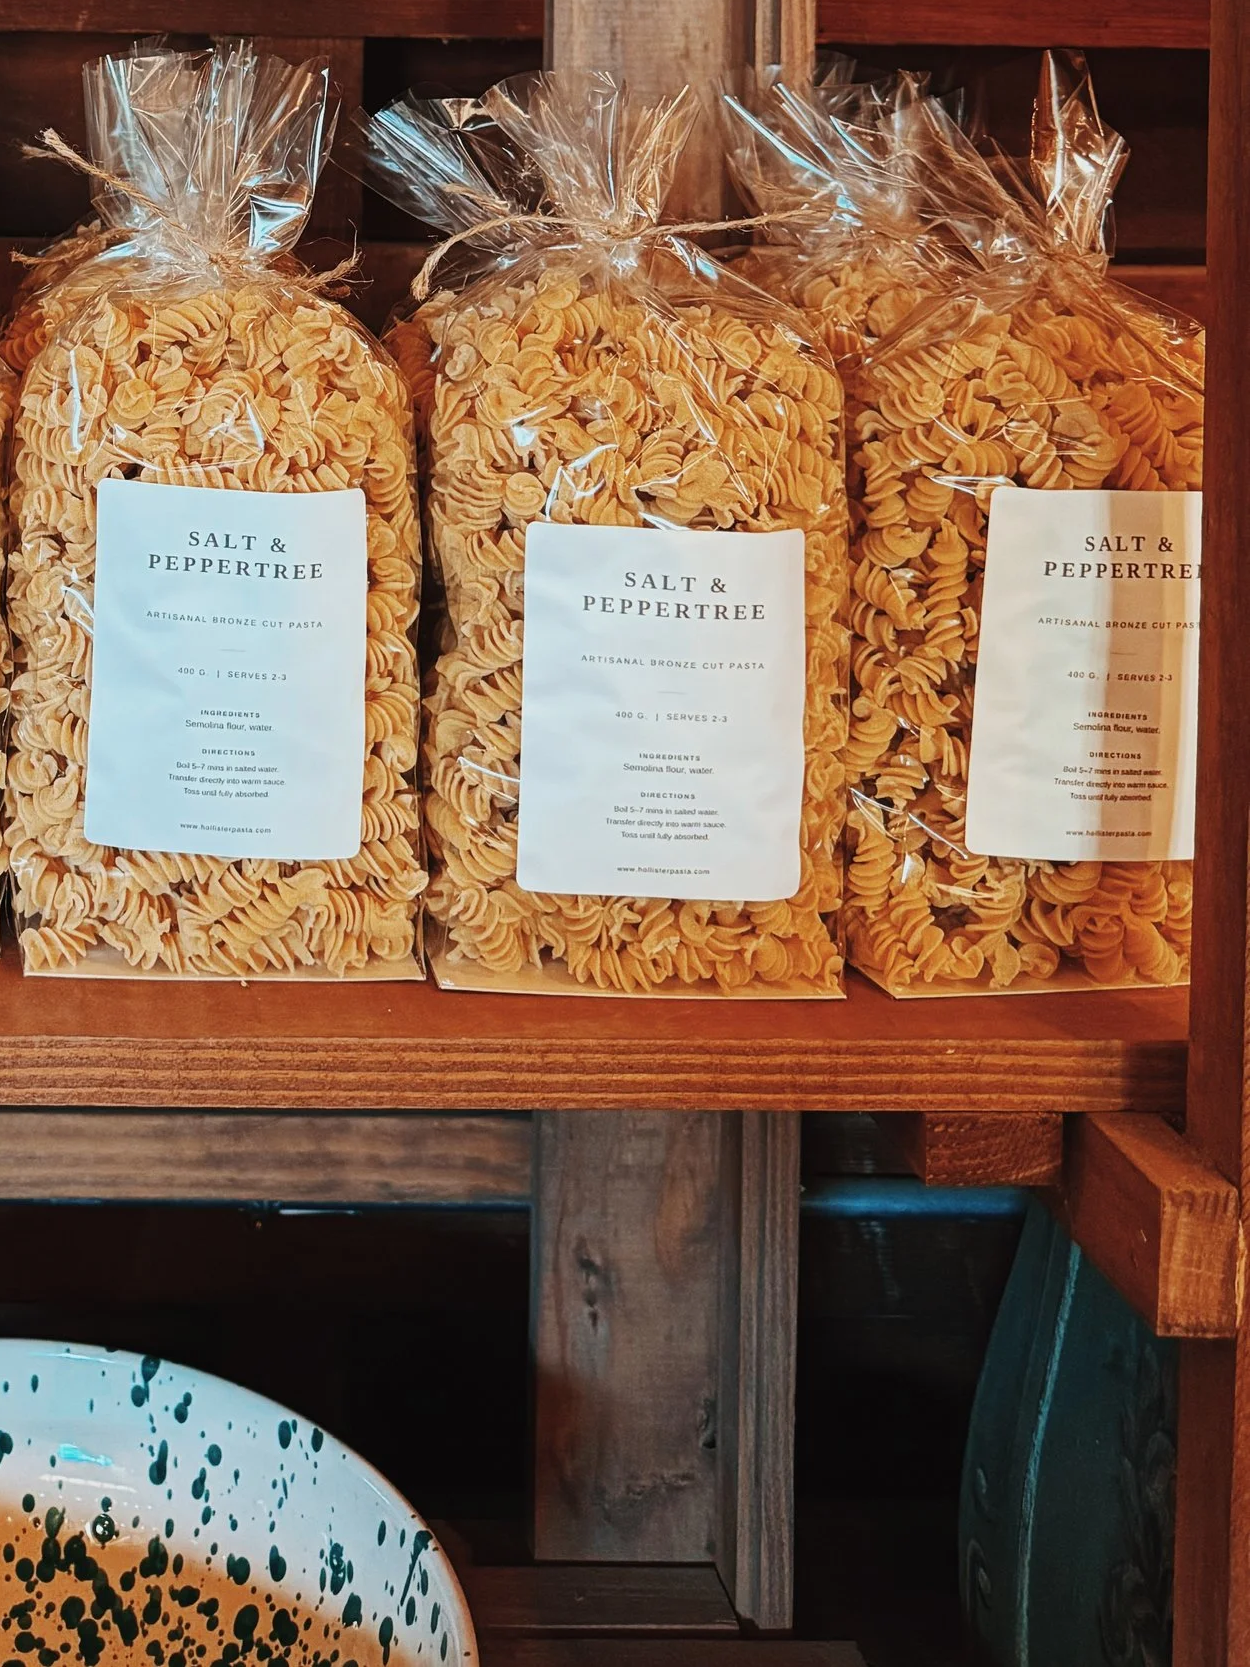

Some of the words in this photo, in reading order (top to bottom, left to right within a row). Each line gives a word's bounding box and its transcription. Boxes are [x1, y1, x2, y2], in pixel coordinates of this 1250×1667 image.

[189, 532, 256, 550] SALT
[271, 538, 285, 553] &
[1085, 536, 1146, 552] SALT
[1158, 537, 1173, 552] &
[149, 551, 322, 579] PEPPERTREE
[625, 572, 696, 592] SALT
[711, 578, 726, 593] &
[584, 596, 764, 620] PEPPERTREE
[147, 611, 206, 622] ARTISANAL
[212, 616, 257, 627] BRONZE
[261, 620, 283, 629] CUT
[288, 621, 323, 629] PASTA
